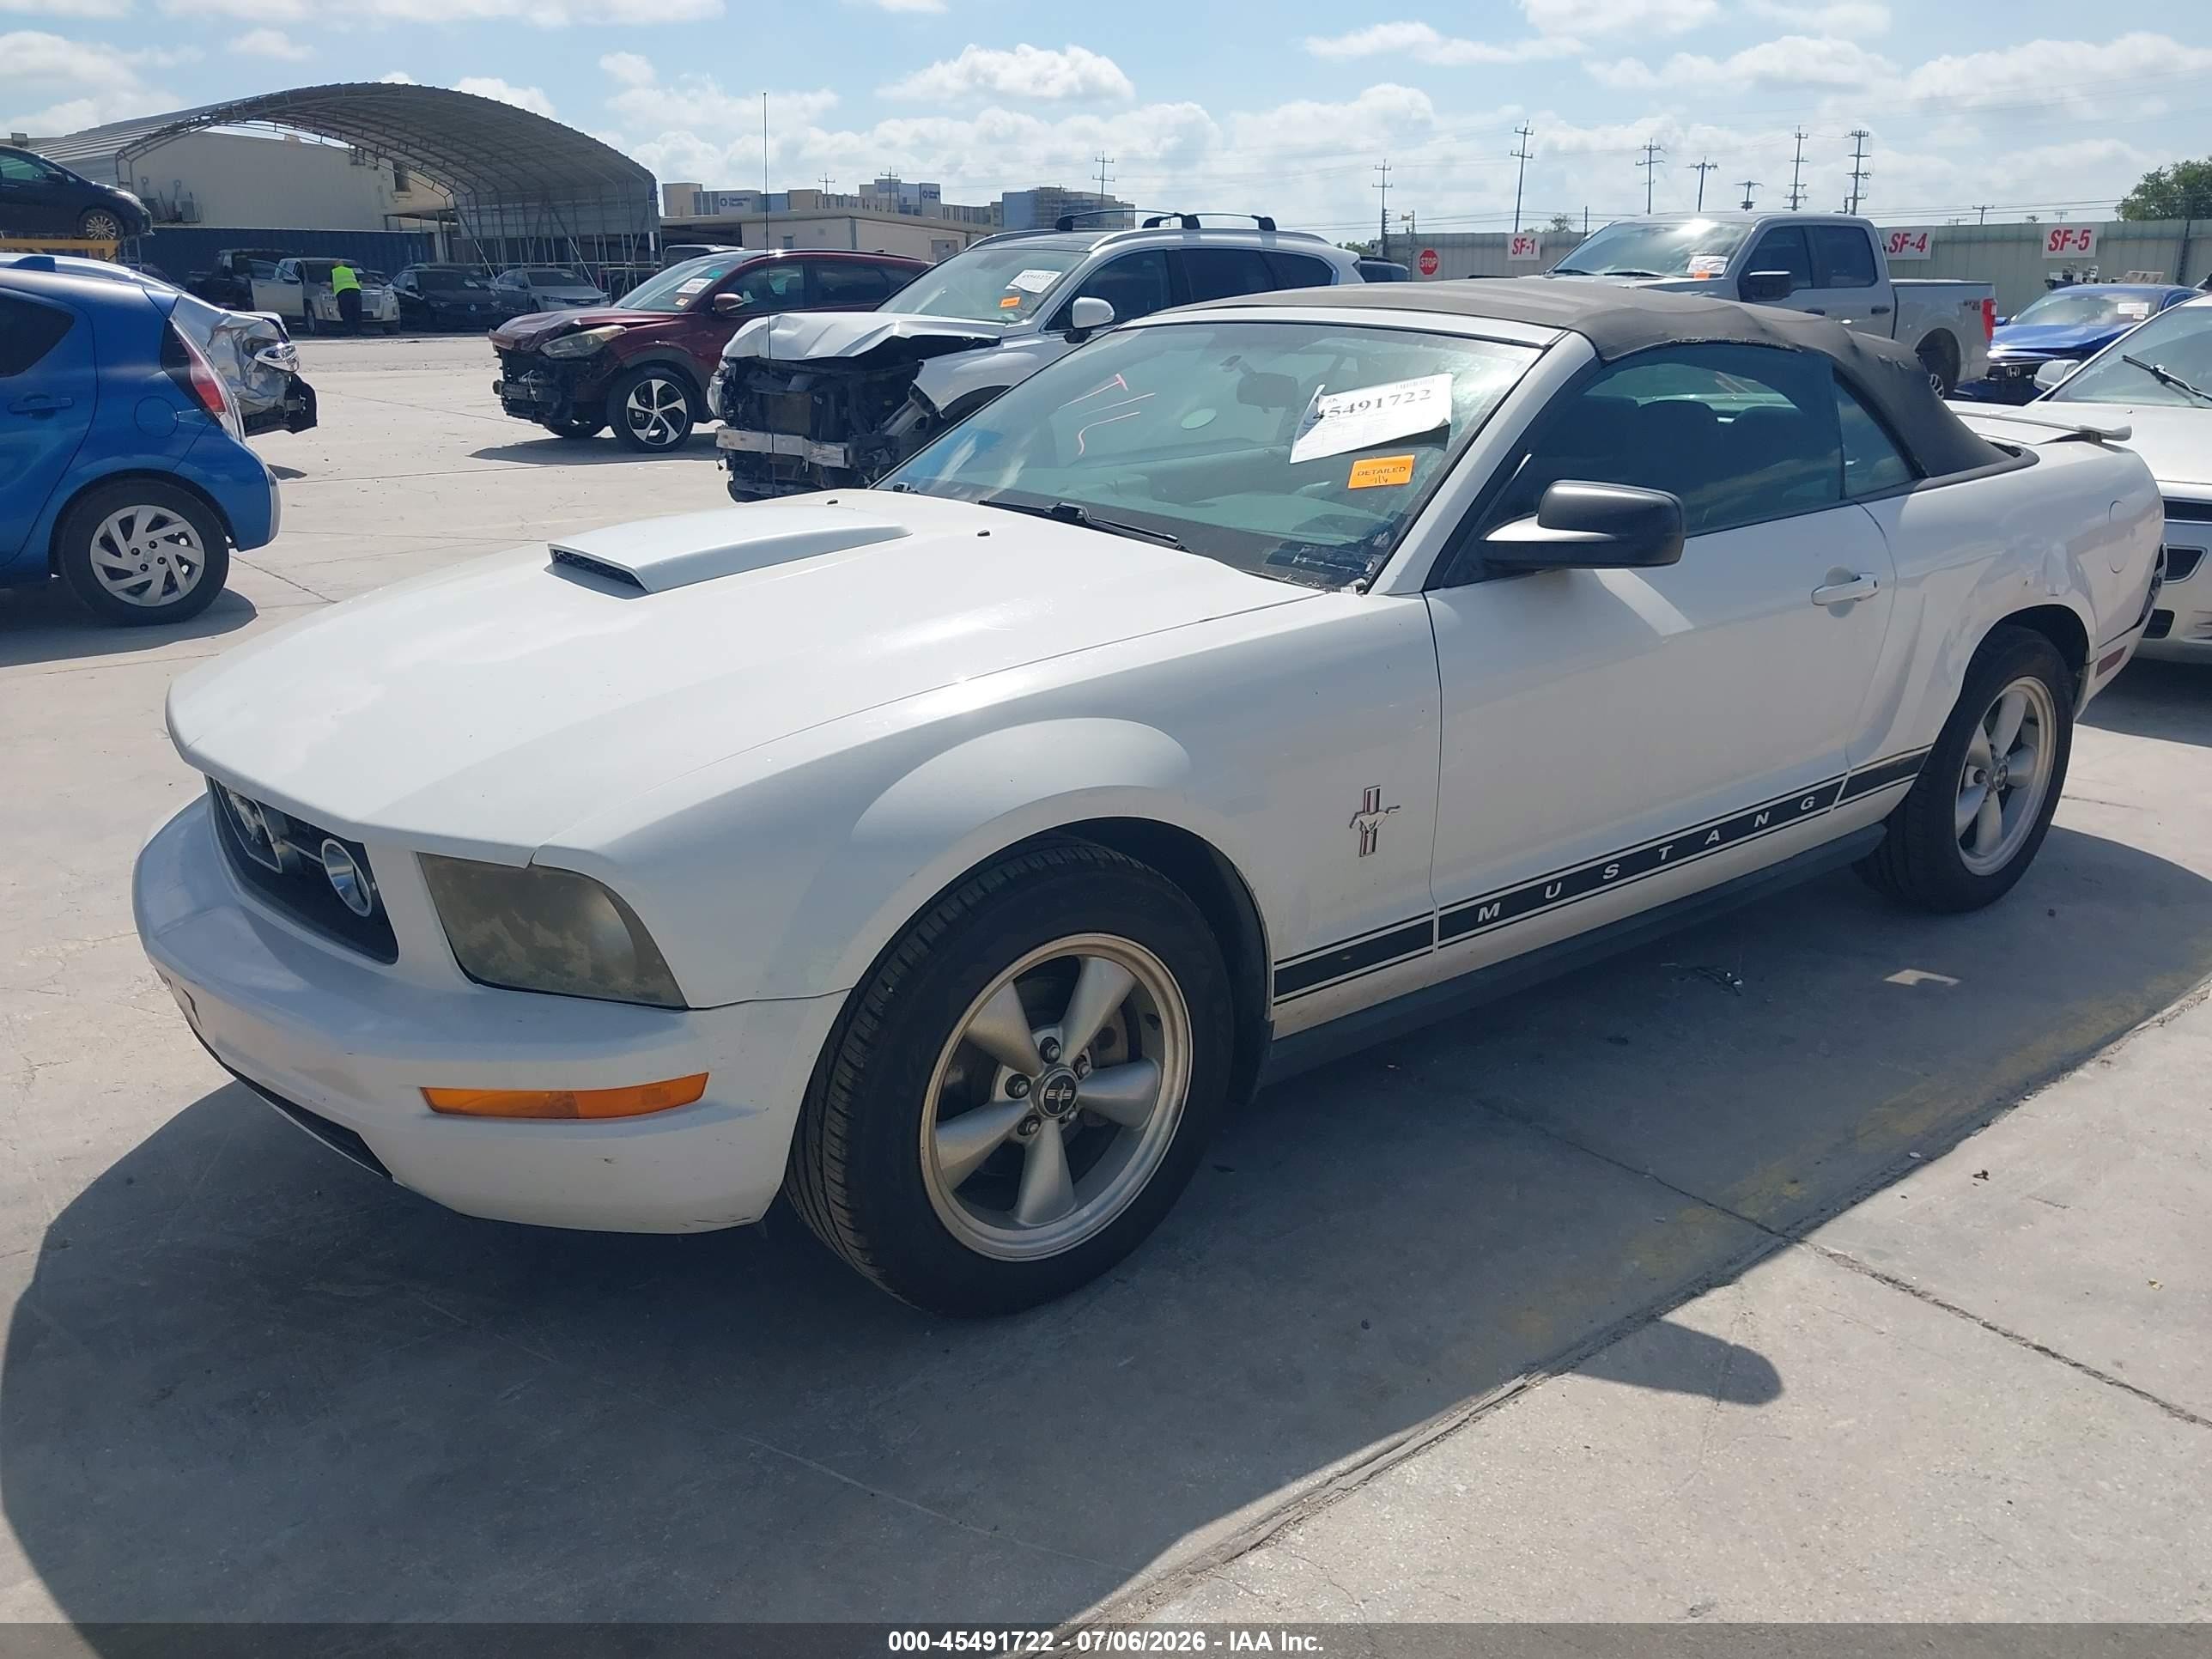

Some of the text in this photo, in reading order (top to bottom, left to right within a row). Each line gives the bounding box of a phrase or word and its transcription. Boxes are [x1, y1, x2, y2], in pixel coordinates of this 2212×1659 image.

[1512, 237, 1535, 255] SF-1
[1889, 233, 1928, 253] SF-4
[2048, 228, 2092, 252] SF-5
[1420, 258, 1437, 269] STOP
[1313, 389, 1431, 419] 45491722
[1357, 466, 1407, 477] DETAILED
[1477, 795, 1817, 923] MUSTANG
